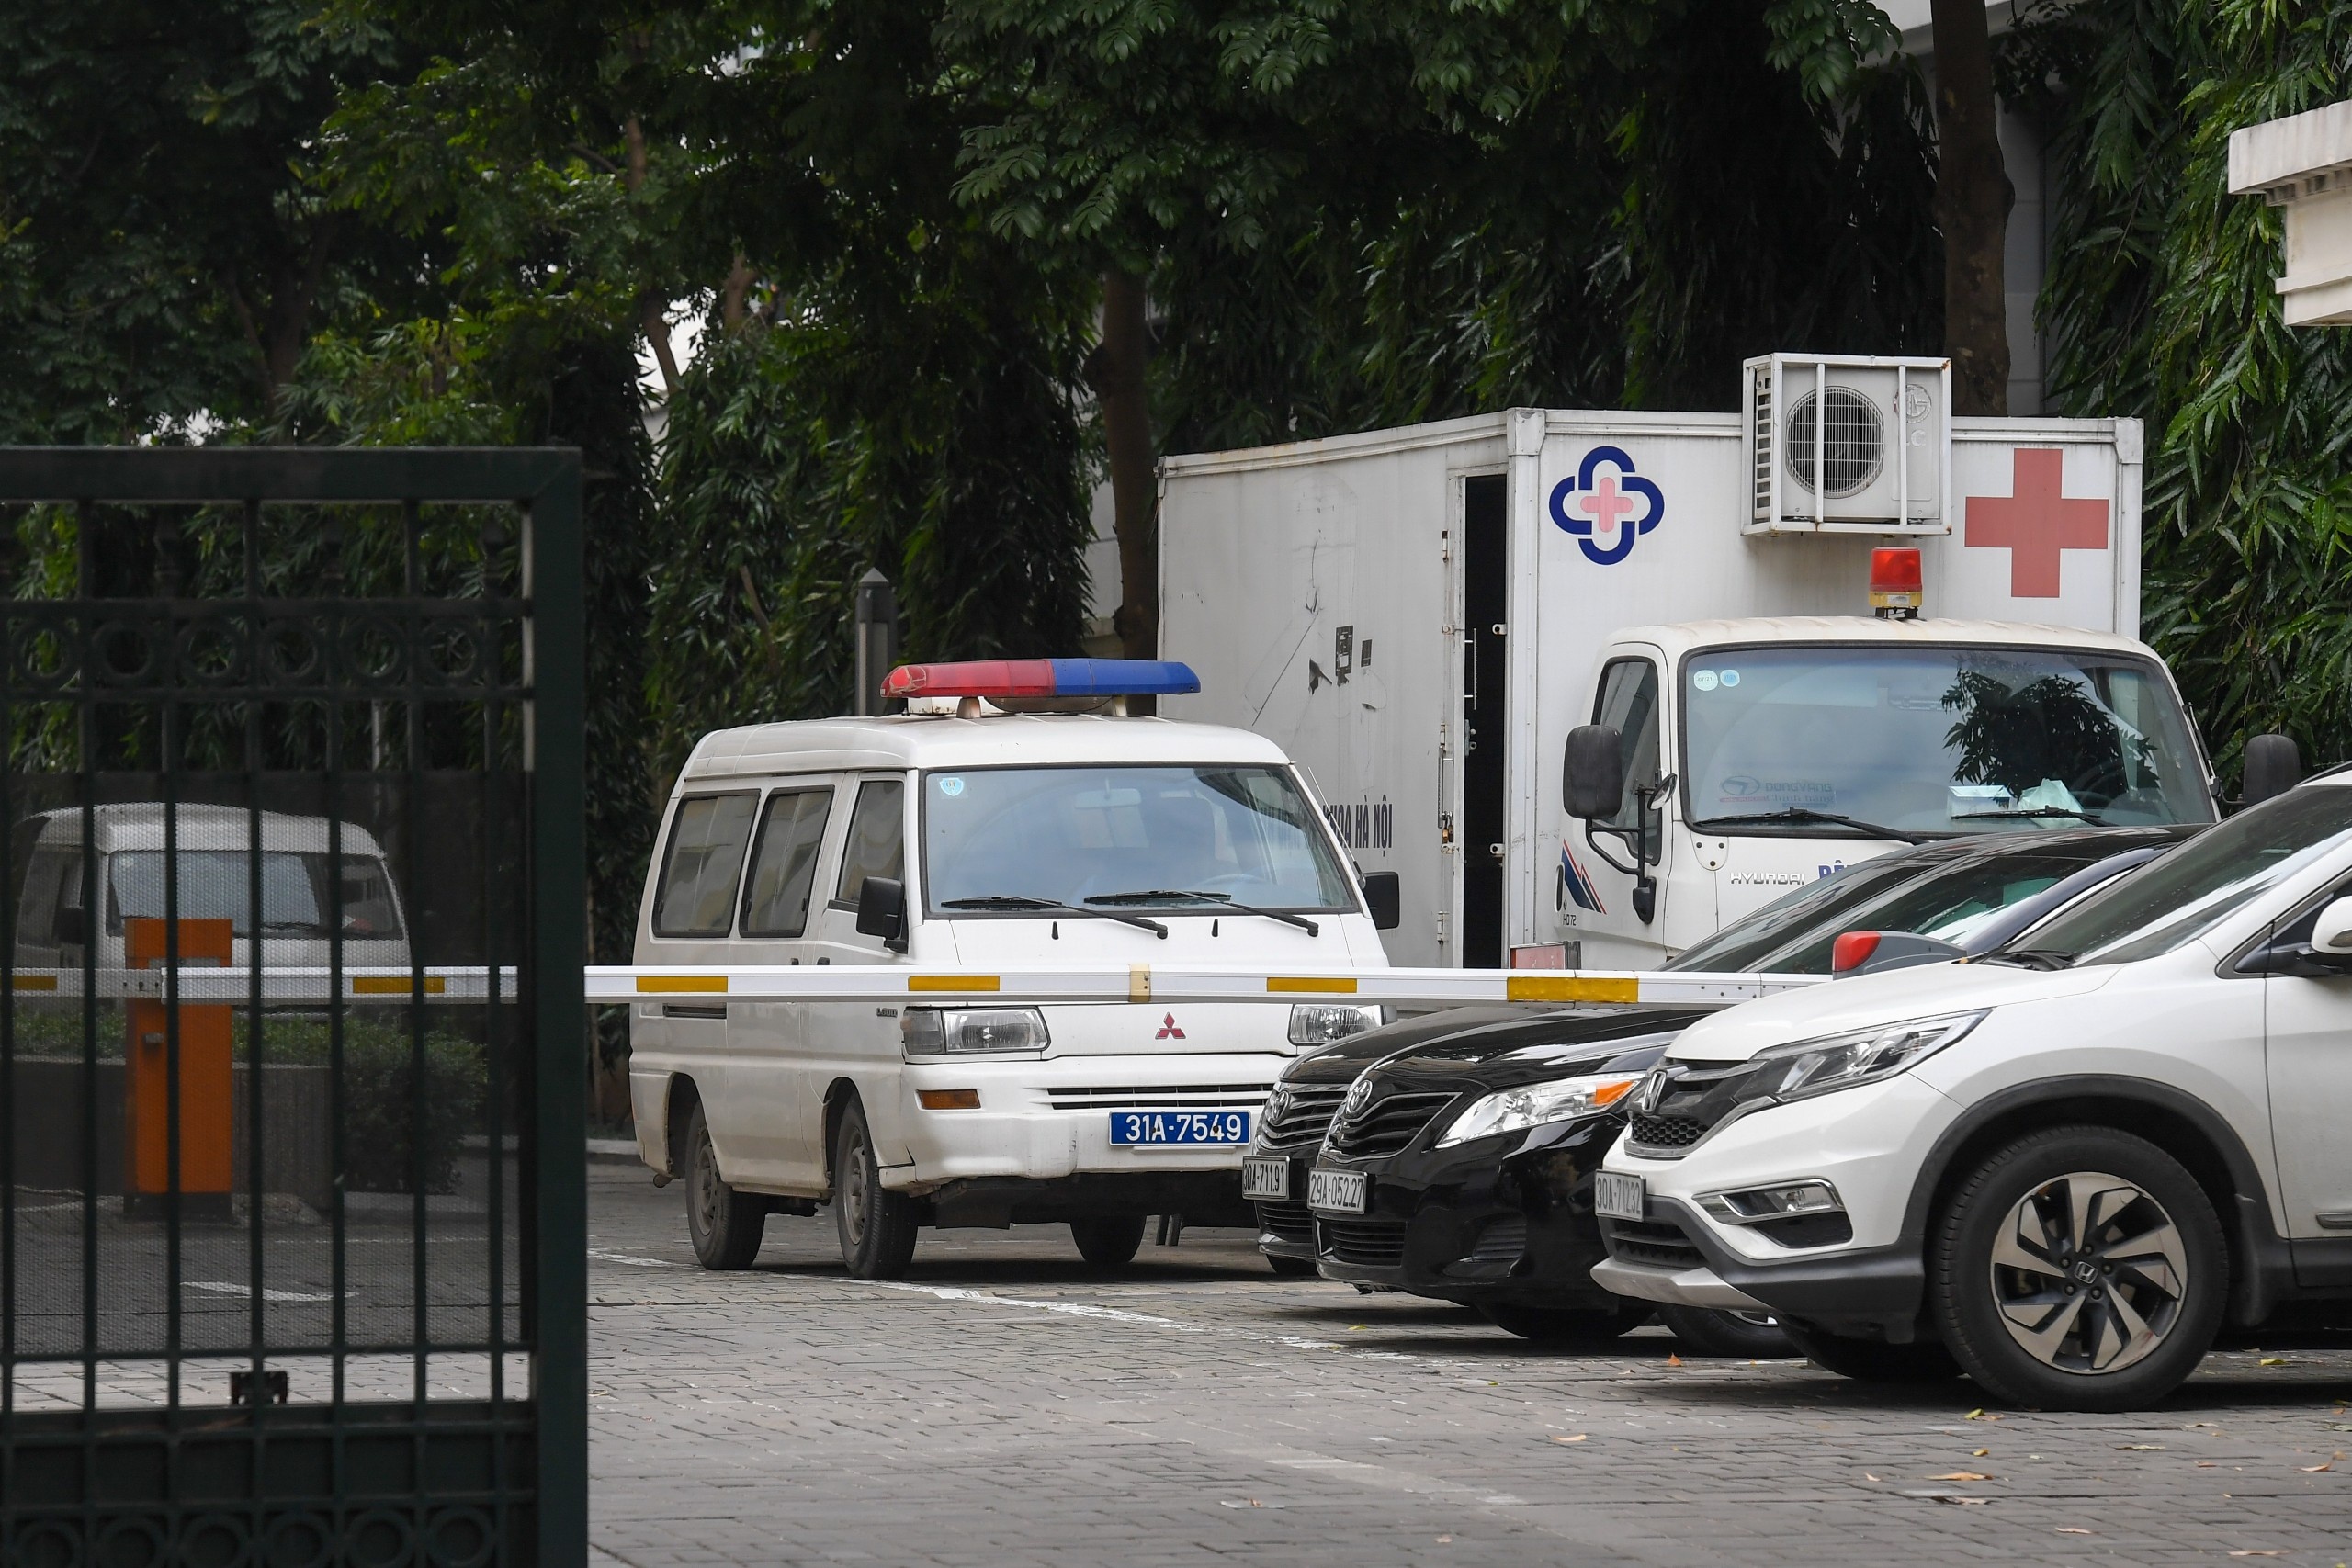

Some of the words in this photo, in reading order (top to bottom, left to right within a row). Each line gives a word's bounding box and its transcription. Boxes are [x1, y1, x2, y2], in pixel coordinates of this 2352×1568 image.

[1355, 795, 1369, 849] HÀ
[1374, 795, 1393, 857] NỘI
[1730, 873, 1805, 886] HYUNDAI
[1125, 1114, 1241, 1142] 31A-7549
[1243, 1163, 1284, 1193] 30A-711.91
[1309, 1173, 1364, 1209] 29A-052.27
